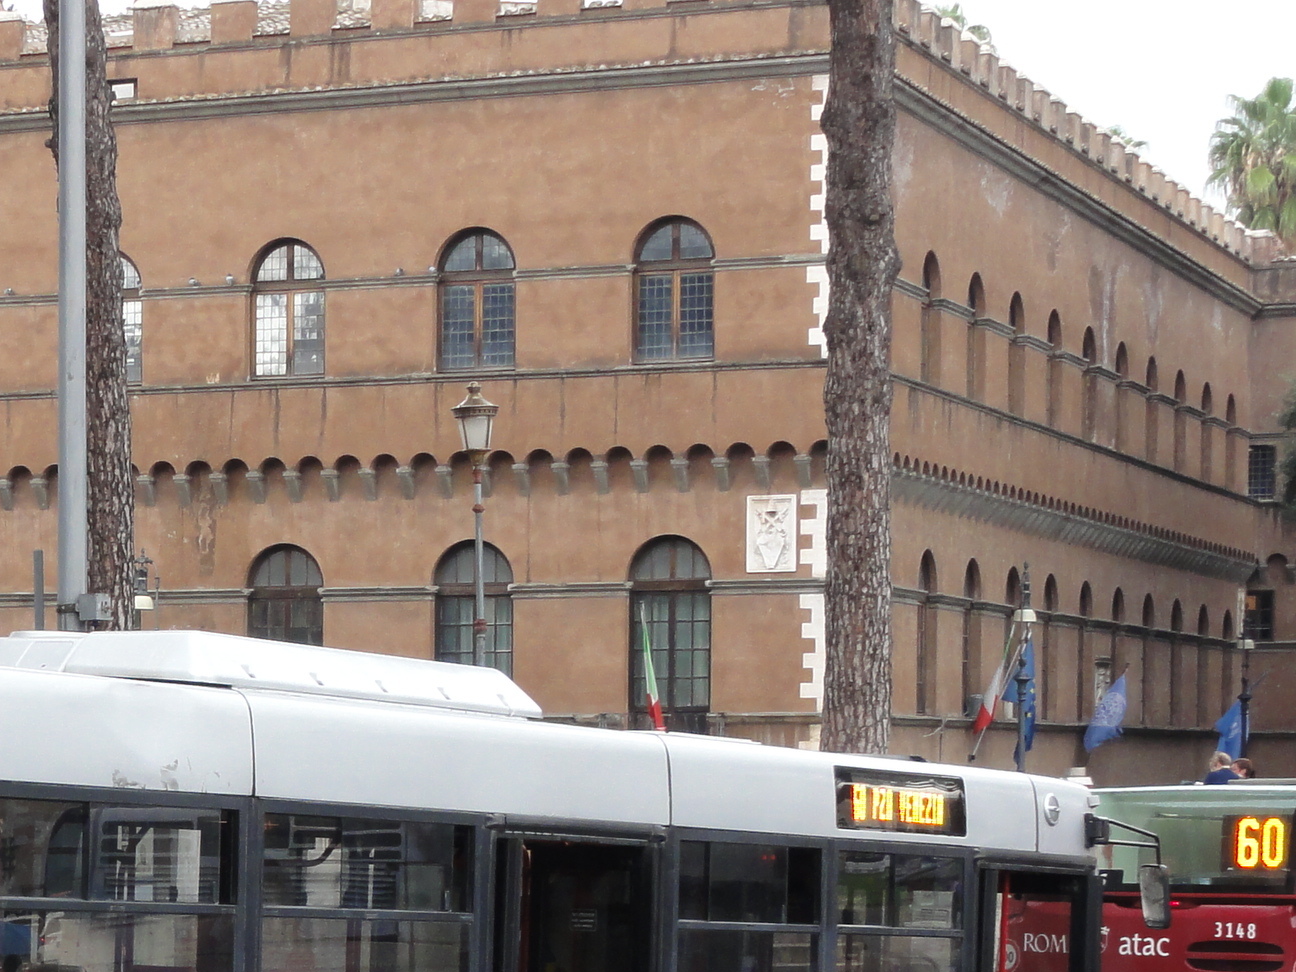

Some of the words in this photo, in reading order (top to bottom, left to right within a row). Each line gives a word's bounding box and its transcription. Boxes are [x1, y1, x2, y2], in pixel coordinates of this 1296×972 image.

[1236, 816, 1285, 868] 60
[1214, 921, 1256, 939] 3148
[1023, 932, 1069, 954] ROM
[1119, 933, 1170, 956] atac
